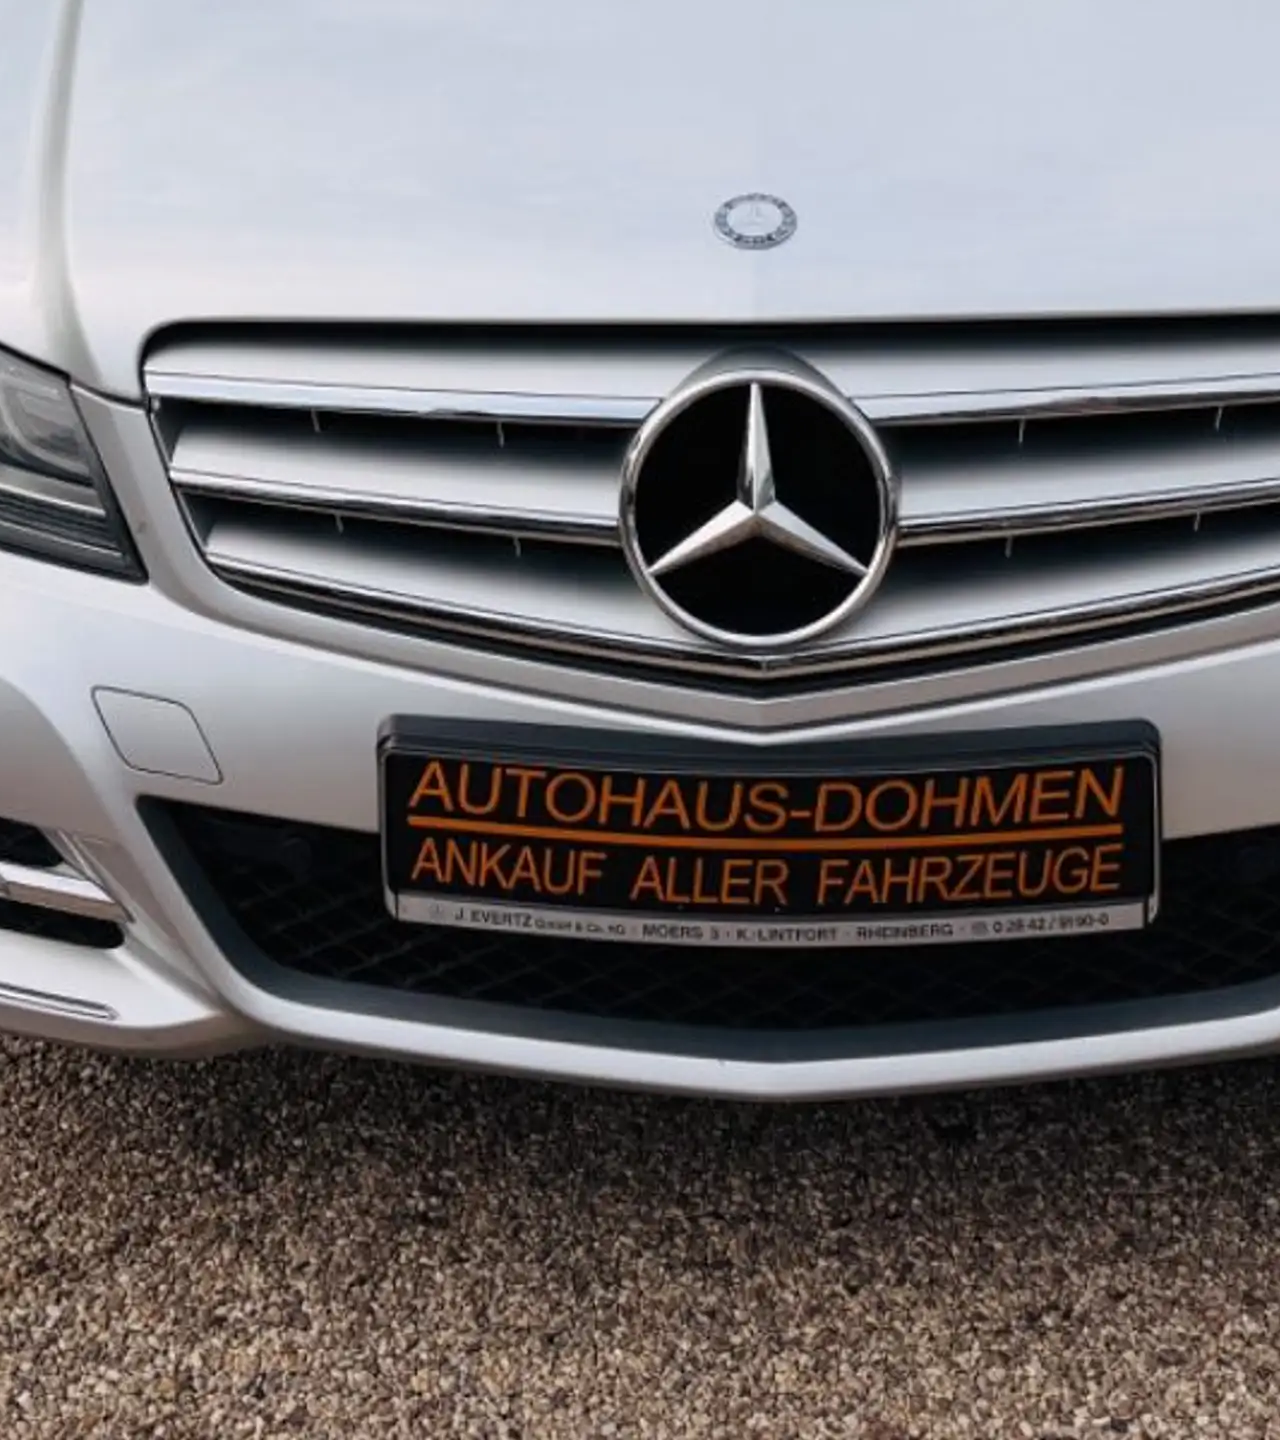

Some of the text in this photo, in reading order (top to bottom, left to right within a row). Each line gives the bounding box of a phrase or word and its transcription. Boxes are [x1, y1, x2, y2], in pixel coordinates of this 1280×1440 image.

[409, 760, 1124, 834] AUTOHAUS-DOHMEN
[411, 838, 1123, 907] ANKAUF ALLER FAHRZEUGE
[470, 910, 533, 928] EVERTZ
[642, 923, 703, 940] MOERS
[856, 922, 954, 941] RHEINBERG
